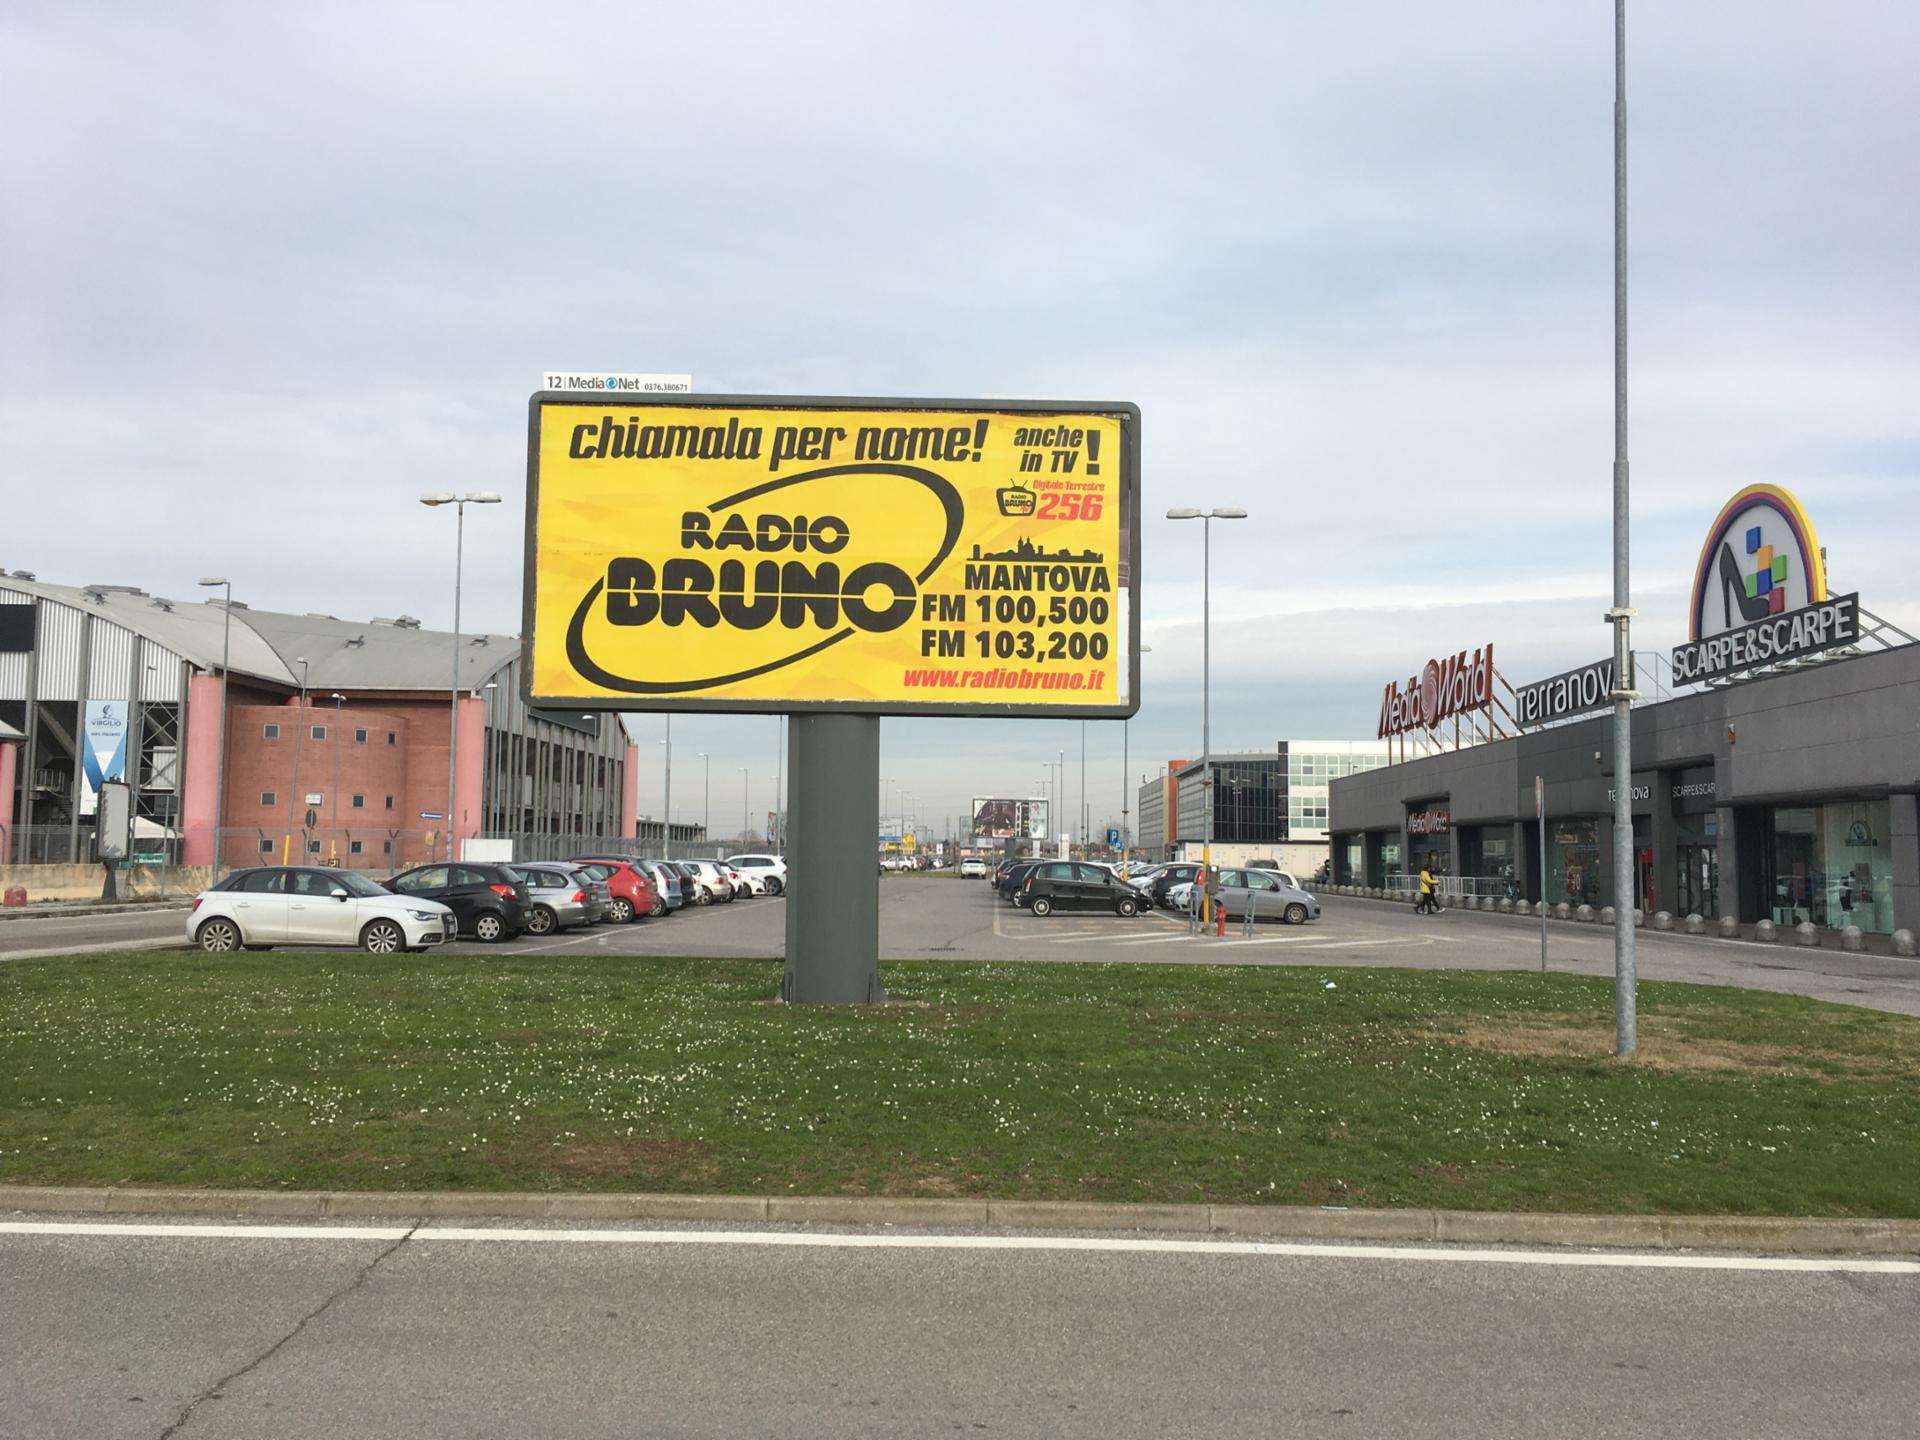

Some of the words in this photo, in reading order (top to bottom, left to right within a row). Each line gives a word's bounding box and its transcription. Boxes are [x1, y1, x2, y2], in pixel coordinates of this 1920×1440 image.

[547, 376, 562, 388] 12
[568, 376, 605, 390] Media
[618, 377, 640, 390] Net
[644, 383, 688, 391] 0376.380671
[569, 416, 763, 460] chiamala
[769, 426, 847, 472] per
[854, 419, 989, 462] nome!
[1013, 425, 1084, 448] anche
[1019, 450, 1043, 472] in
[1050, 450, 1079, 473] TV
[1033, 479, 1063, 491] Digitale
[1065, 481, 1105, 491] Terrestre
[1005, 499, 1032, 507] BRUNO
[1036, 493, 1104, 521] 256
[681, 511, 850, 554] RADIO
[965, 564, 1111, 592] MANTOVA
[606, 557, 917, 633] BRUNO
[922, 594, 966, 622] FM
[975, 595, 1109, 627] 100,500
[921, 629, 965, 657] FM
[975, 630, 1109, 663] 103,200
[1672, 600, 1853, 682] SCARPE&SCARPE
[903, 668, 1105, 690] www.radiobruno.it
[1517, 664, 1615, 722] Terranov
